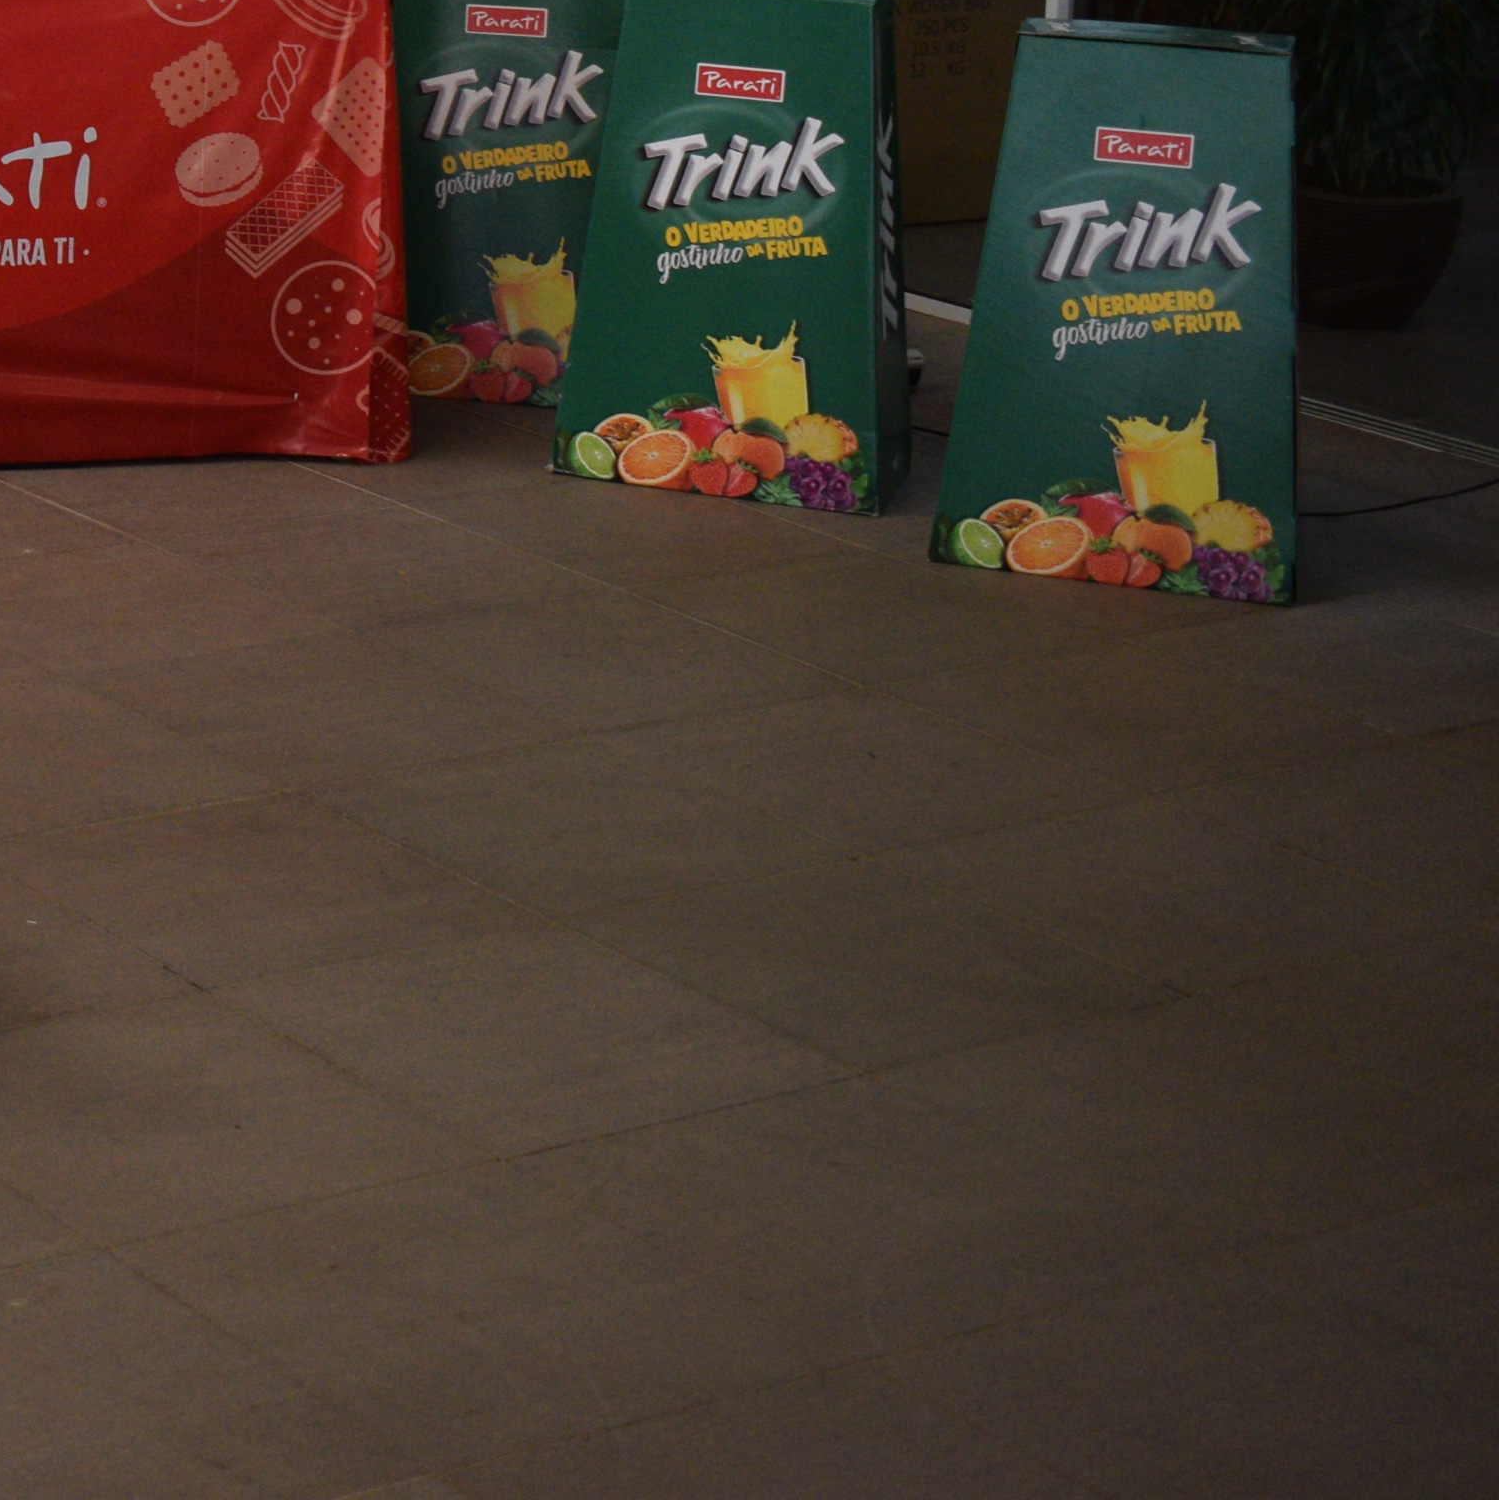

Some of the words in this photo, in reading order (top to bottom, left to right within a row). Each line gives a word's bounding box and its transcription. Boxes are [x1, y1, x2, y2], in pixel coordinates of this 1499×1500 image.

[472, 11, 540, 30] Parati
[420, 51, 604, 141] Trink
[703, 71, 777, 94] Parati
[442, 156, 457, 174] O
[459, 141, 568, 170] VERDADEIRO
[645, 117, 845, 210] Trink
[1102, 135, 1185, 160] Parati
[435, 169, 514, 209] gostinho
[517, 167, 533, 181] DA
[535, 160, 592, 182] FRUTA
[666, 226, 681, 247] O
[683, 216, 802, 243] VERDADEIRO
[1040, 183, 1261, 281] Trink
[54, 237, 74, 264] TI
[657, 243, 743, 284] gostinho
[746, 242, 765, 257] DA
[766, 237, 828, 259] FRUTA
[1062, 299, 1079, 321] O
[1082, 288, 1215, 317] VERDADEIRO
[1053, 318, 1148, 361] gostinho
[1151, 317, 1172, 332] DA
[1173, 311, 1242, 335] FRUTA
